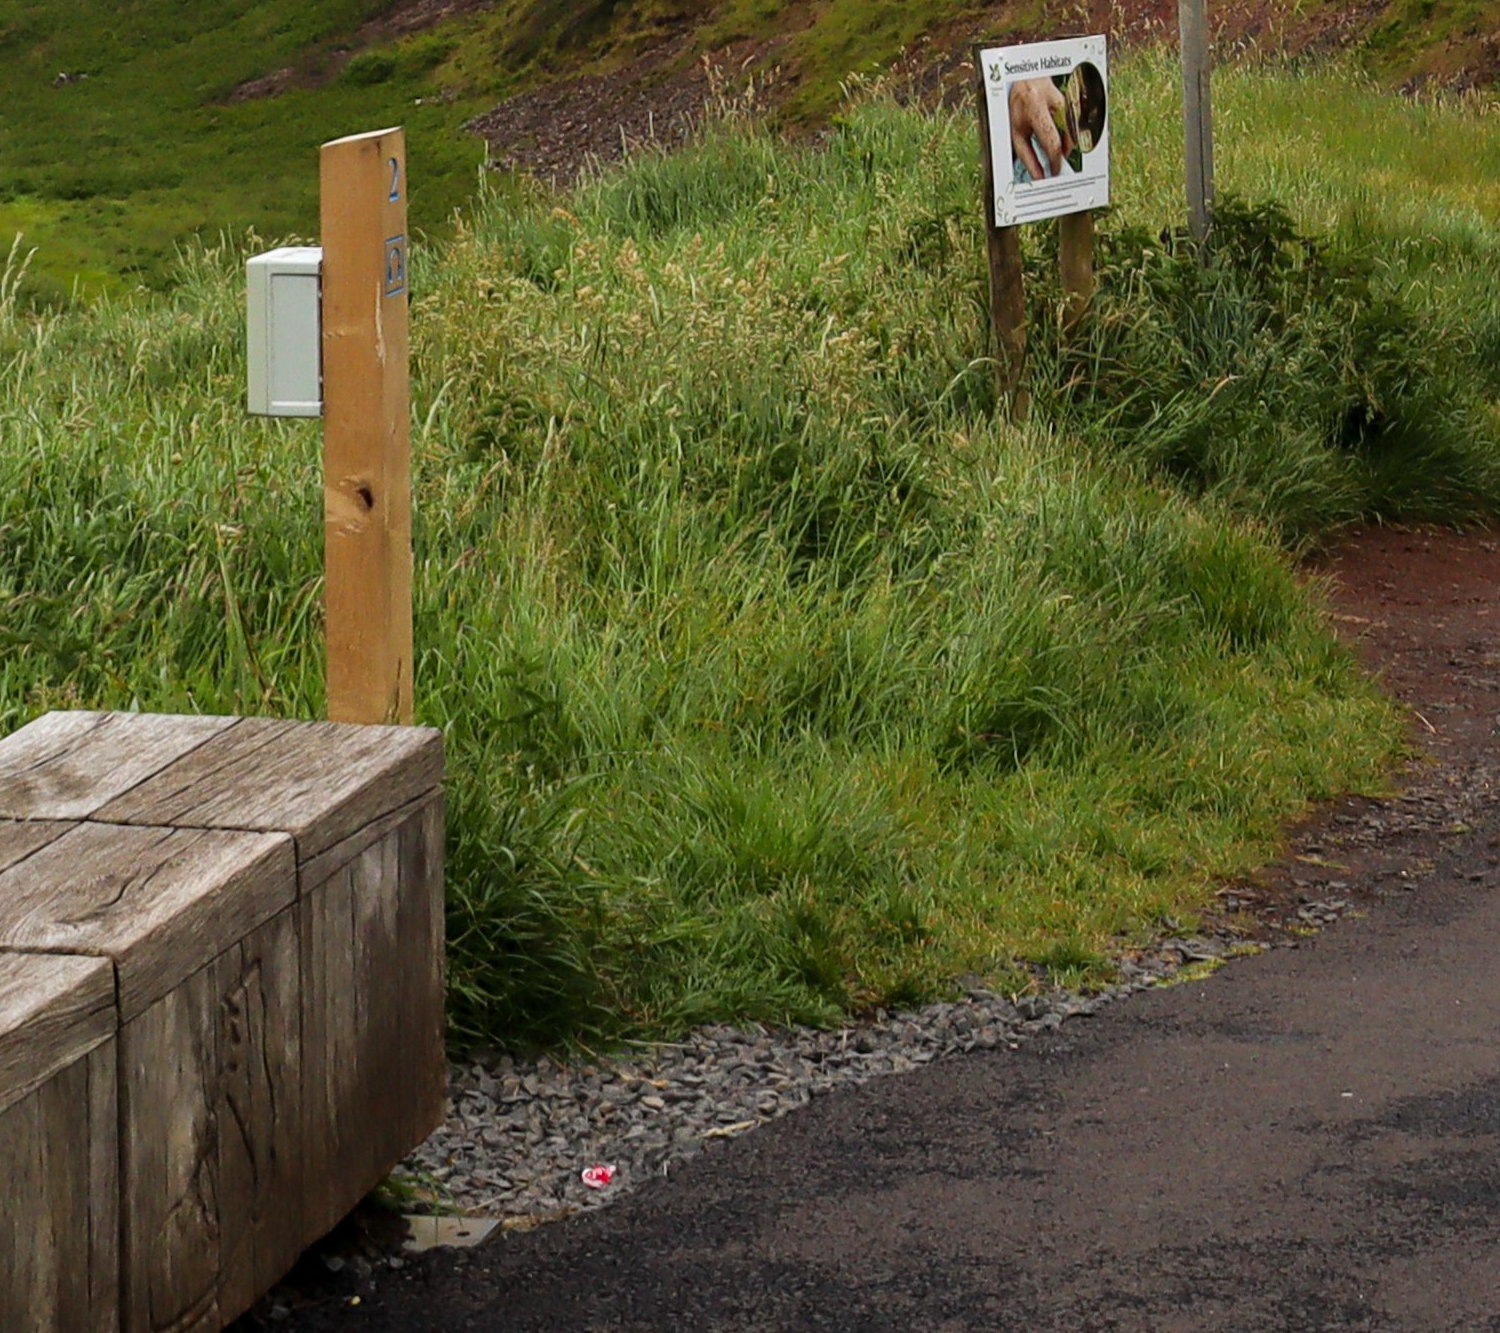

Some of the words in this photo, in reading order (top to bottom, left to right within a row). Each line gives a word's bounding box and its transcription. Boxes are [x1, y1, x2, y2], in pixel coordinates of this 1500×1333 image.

[1004, 60, 1039, 75] Sensitive
[1040, 55, 1072, 70] Habitats
[388, 157, 400, 202] 2
